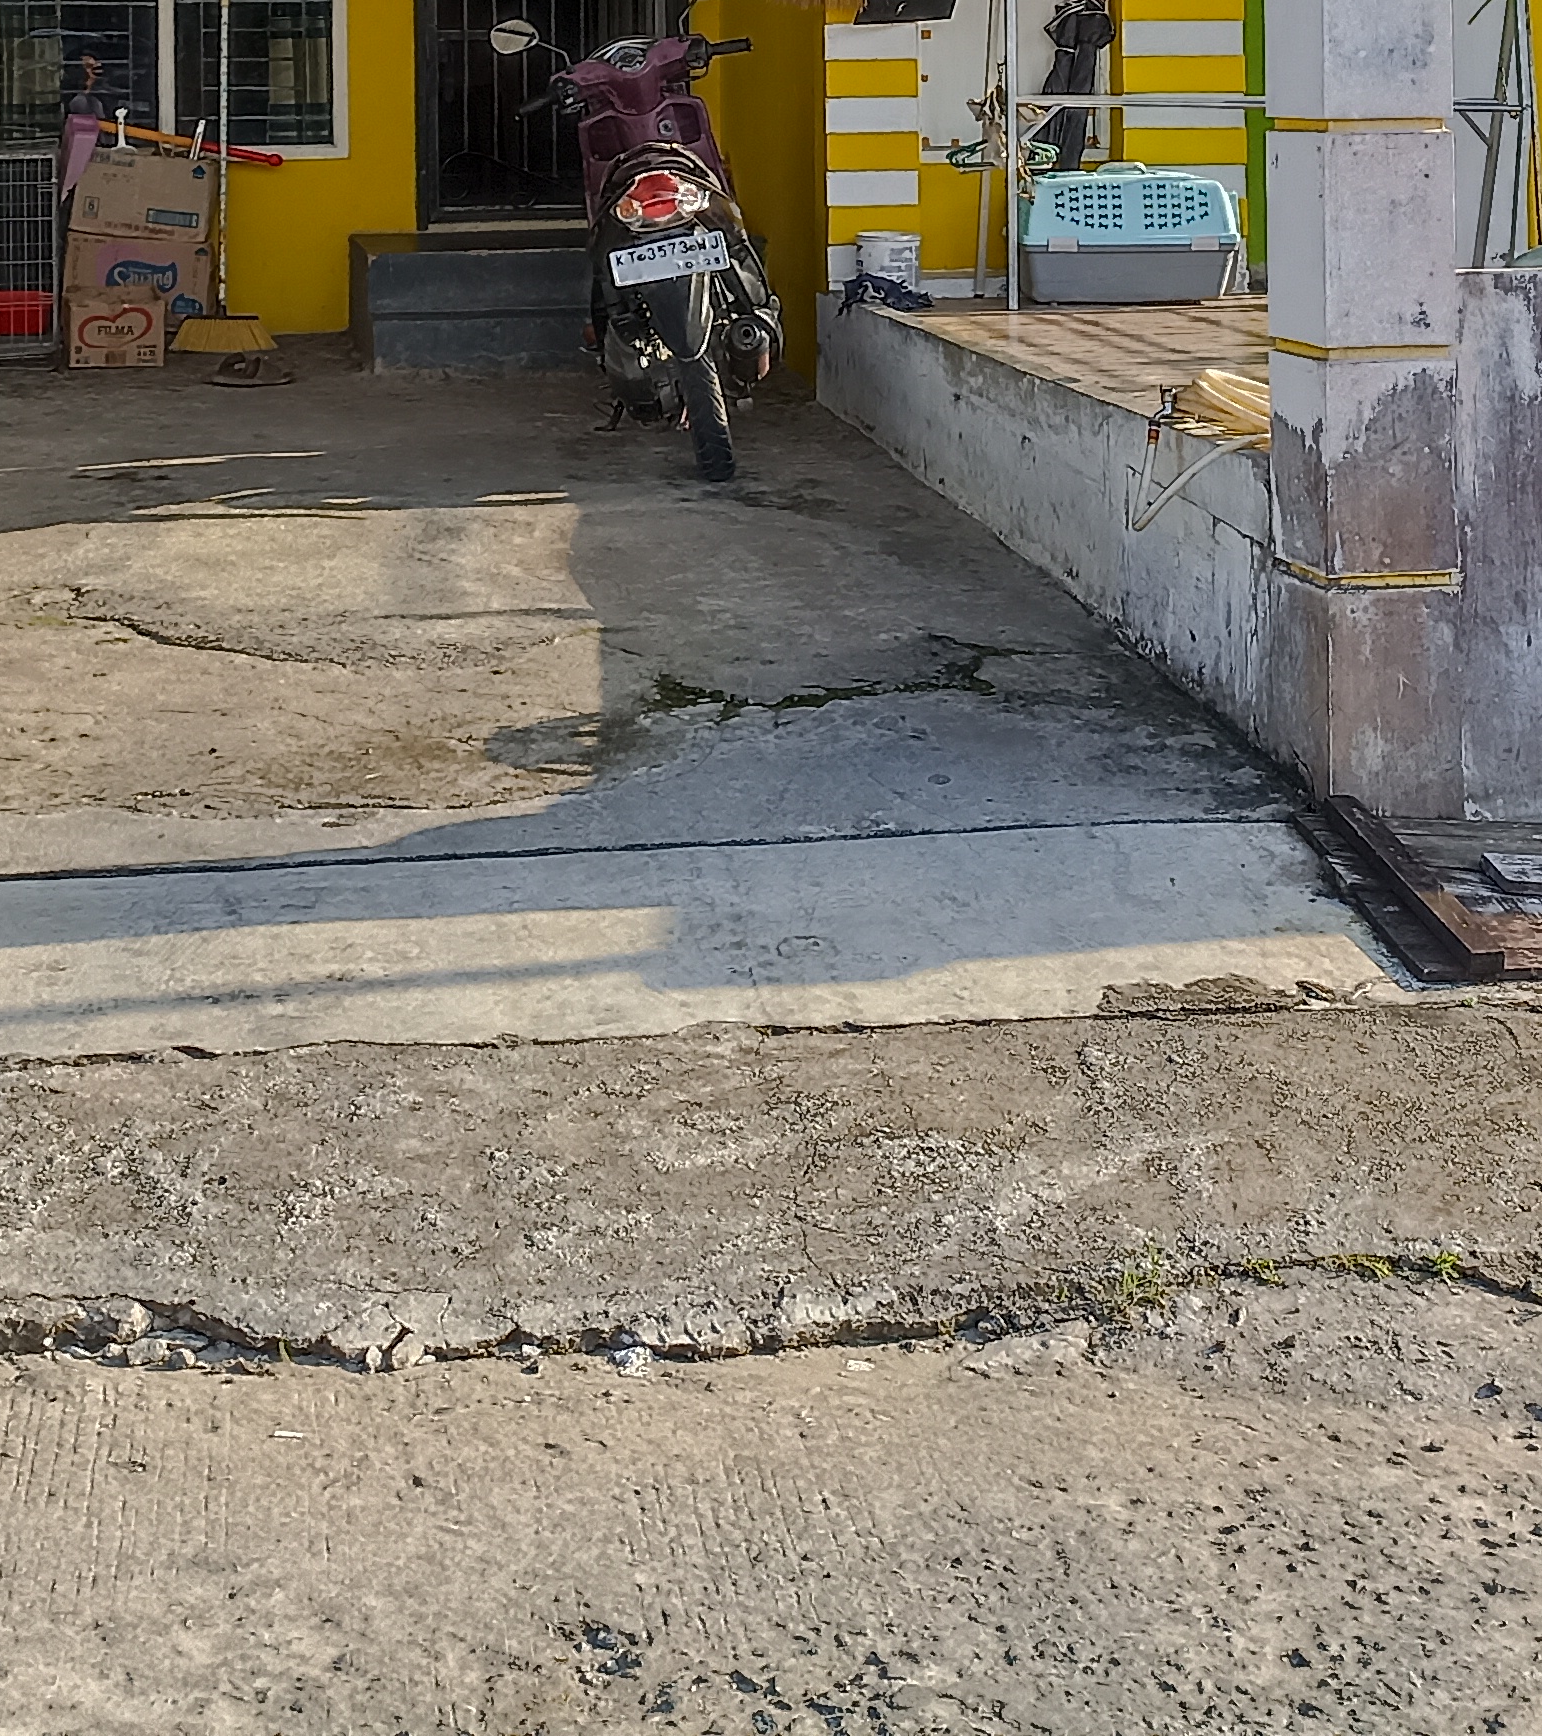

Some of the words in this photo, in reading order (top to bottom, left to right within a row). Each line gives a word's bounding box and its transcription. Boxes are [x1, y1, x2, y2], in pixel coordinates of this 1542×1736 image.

[615, 251, 637, 266] KT
[647, 240, 689, 260] 3573
[97, 326, 134, 336] FILMA
